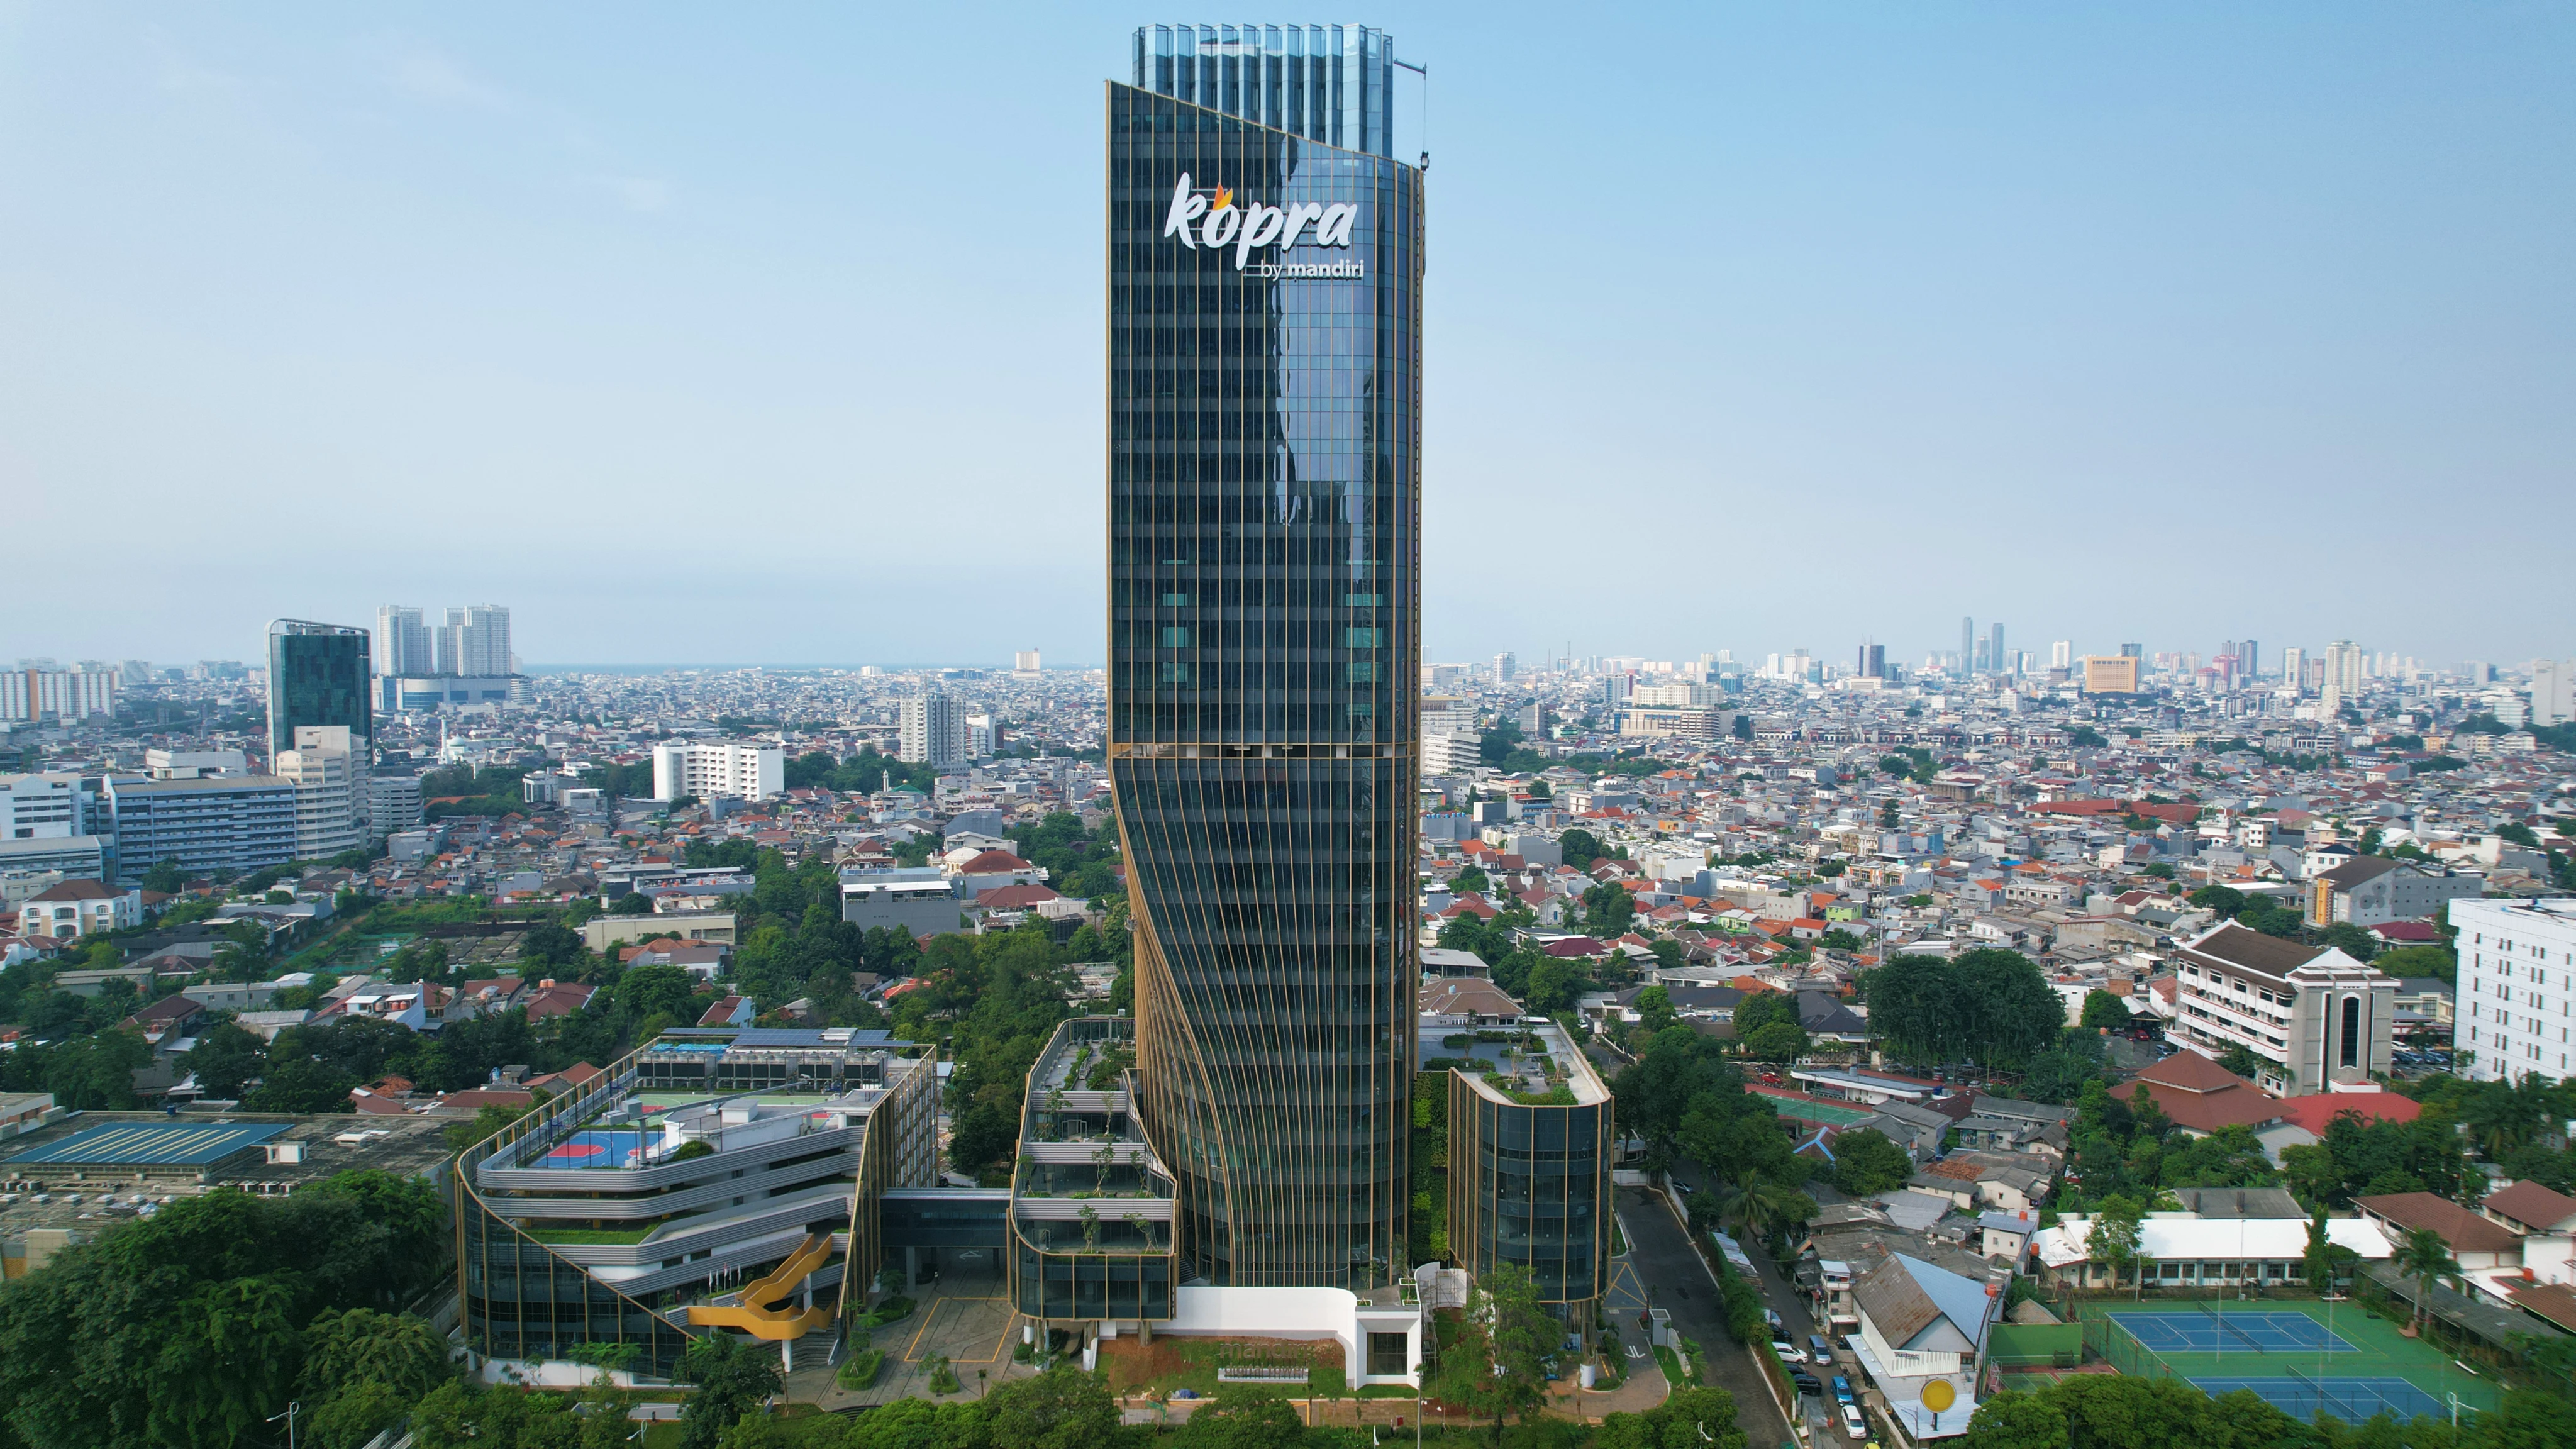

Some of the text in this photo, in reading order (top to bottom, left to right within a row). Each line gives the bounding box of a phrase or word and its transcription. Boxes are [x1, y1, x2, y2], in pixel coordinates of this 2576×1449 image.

[1164, 172, 1357, 270] kopra
[1261, 259, 1364, 282] by mandiri
[1219, 1341, 1308, 1359] mandiri
[1224, 1362, 1307, 1377] digital tower
